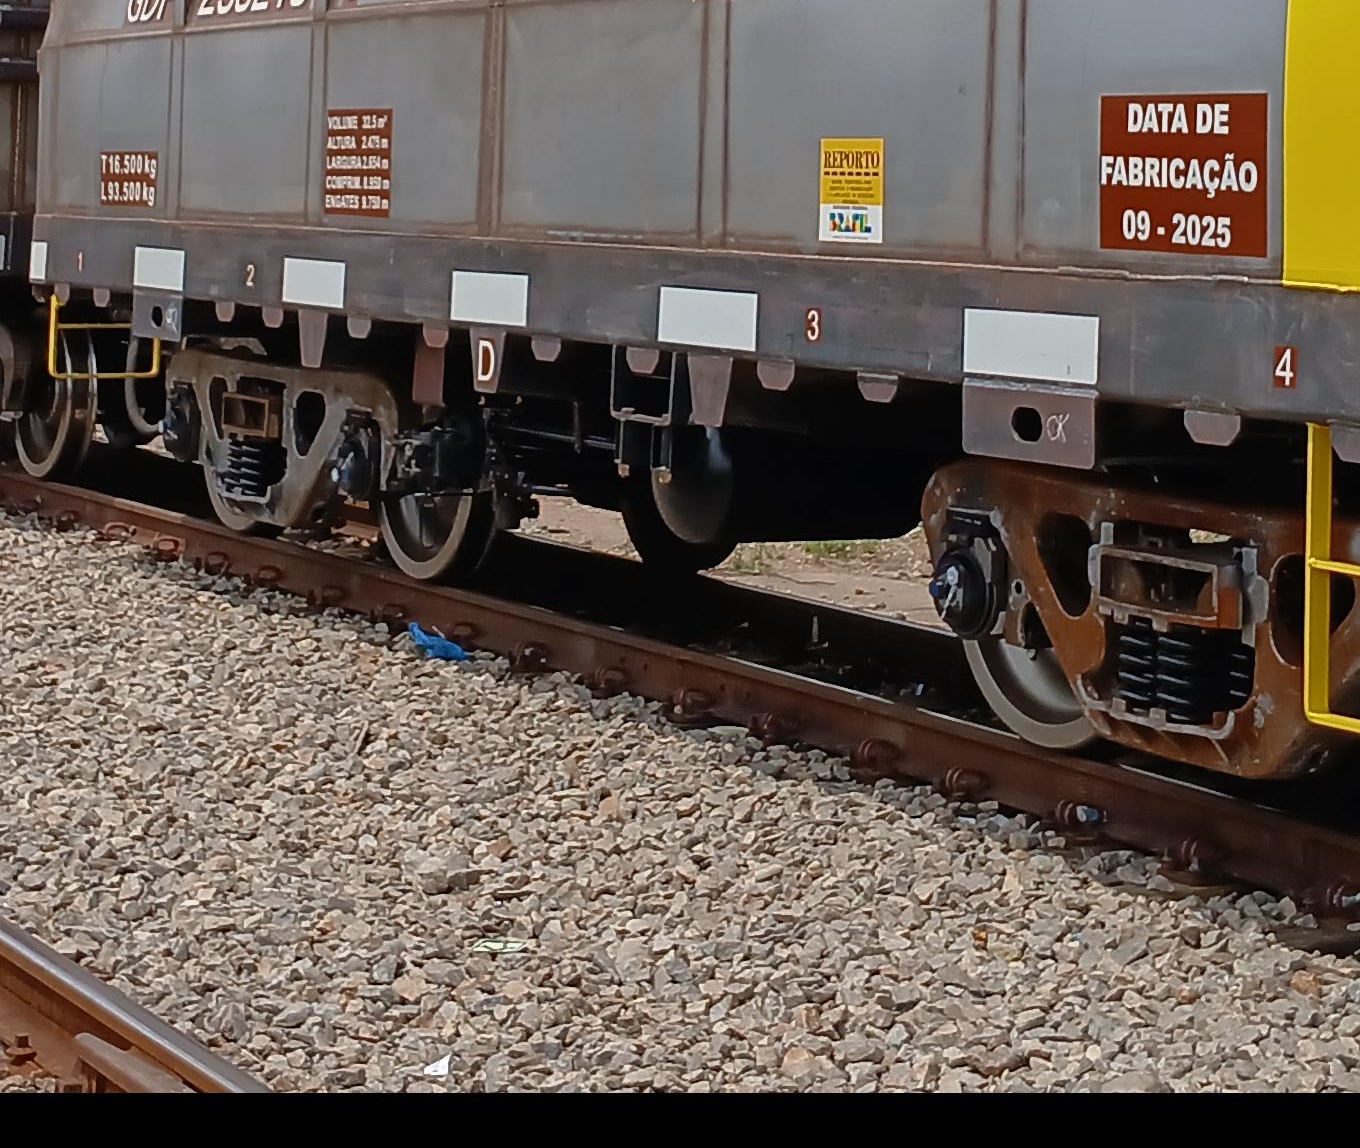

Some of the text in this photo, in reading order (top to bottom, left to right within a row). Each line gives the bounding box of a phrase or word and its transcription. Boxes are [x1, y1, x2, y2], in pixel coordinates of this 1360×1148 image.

[1127, 102, 1230, 135] DATA DE
[327, 135, 357, 149] ALTURA
[144, 154, 157, 179] kg
[824, 150, 880, 169] REPORTO
[1101, 153, 1258, 199] FABRICAÇÃO
[142, 181, 155, 206] kg
[325, 194, 360, 209] ENGATES
[1122, 209, 1232, 248] 09 - 2025
[245, 264, 256, 287] 2
[807, 310, 819, 341] 3
[477, 339, 495, 381] D
[1275, 348, 1294, 386] 4
